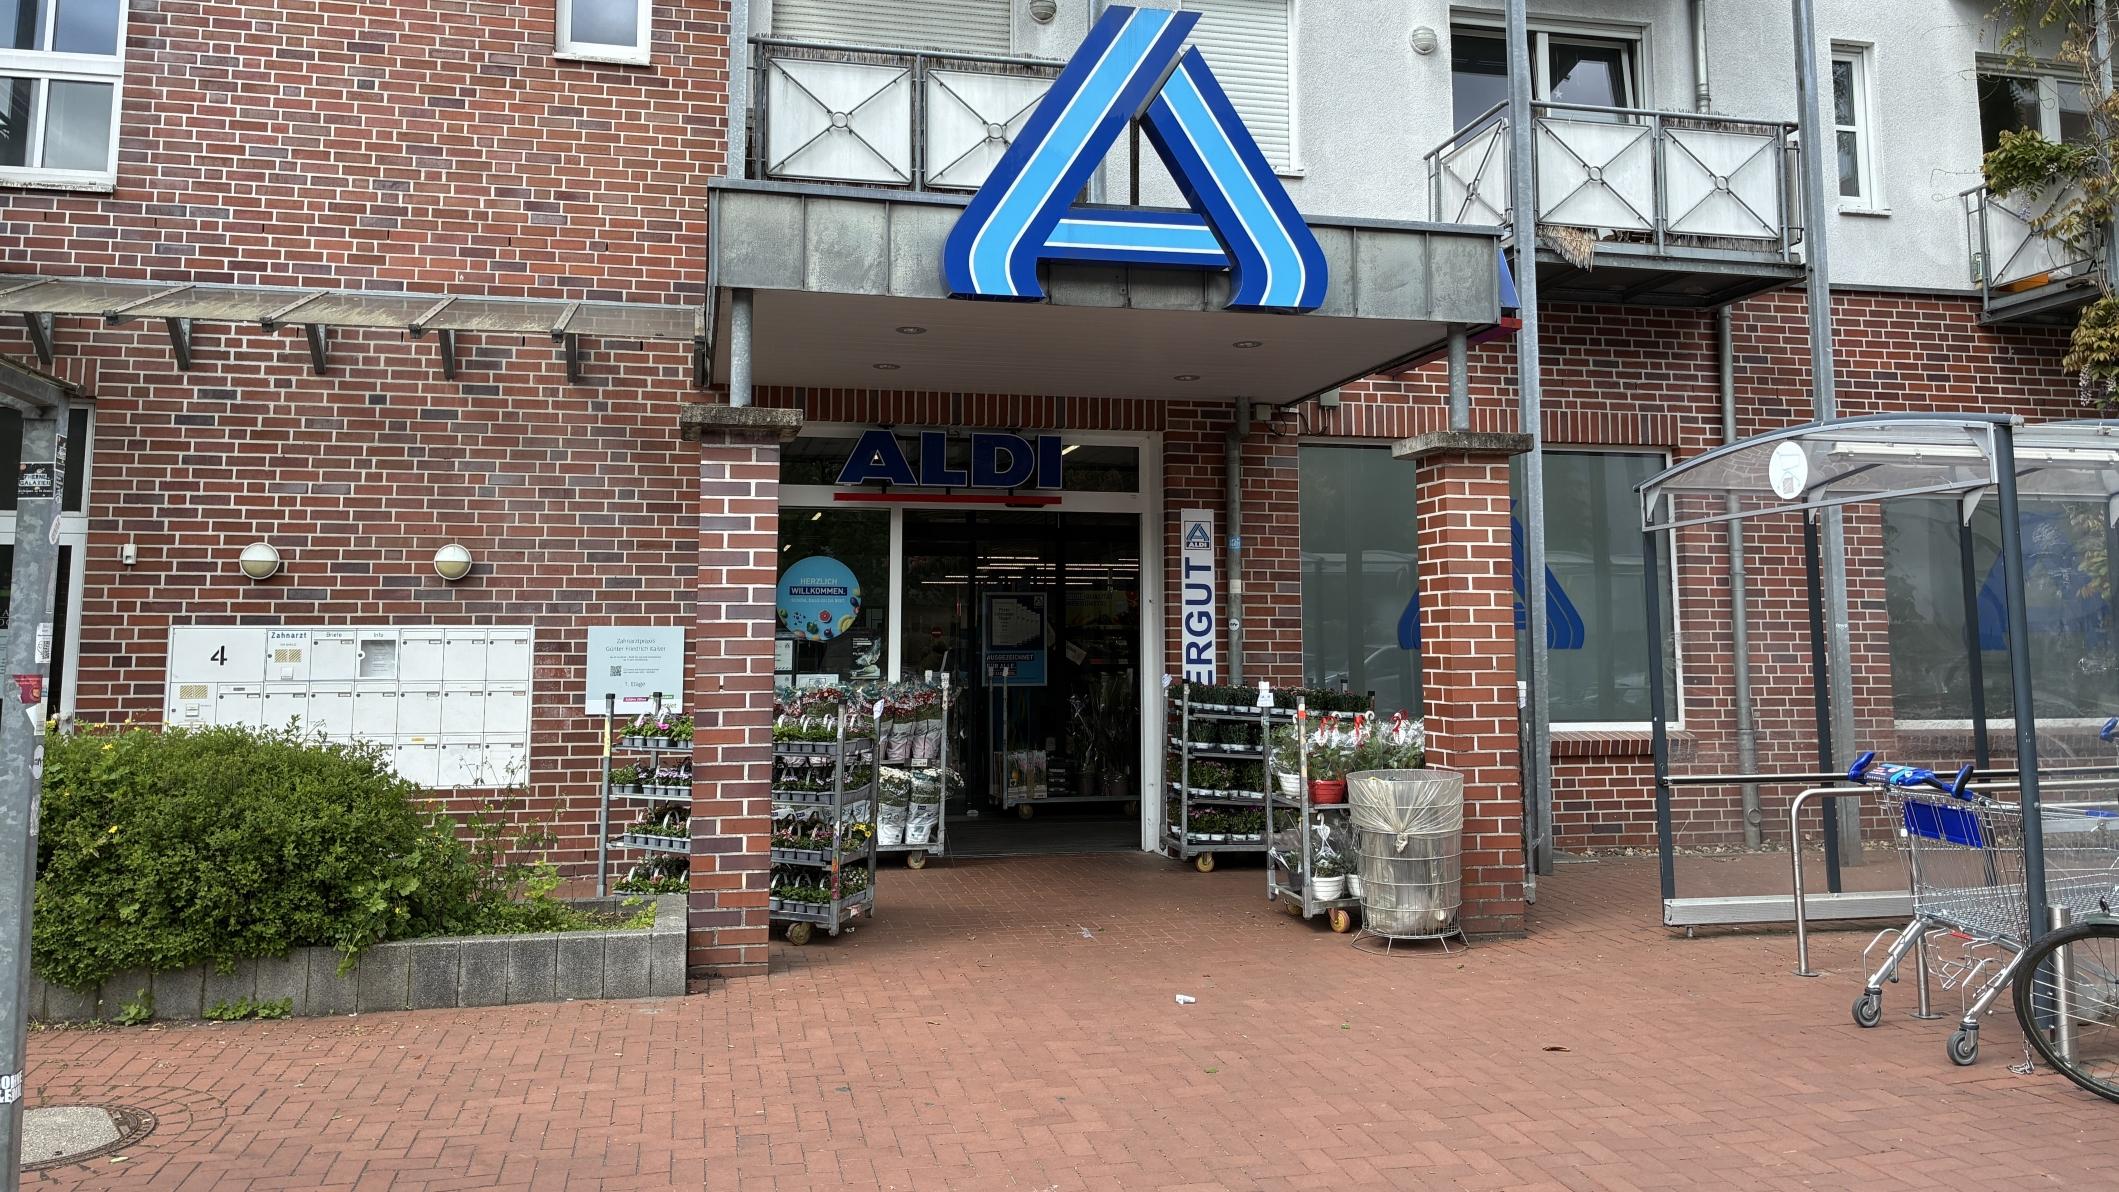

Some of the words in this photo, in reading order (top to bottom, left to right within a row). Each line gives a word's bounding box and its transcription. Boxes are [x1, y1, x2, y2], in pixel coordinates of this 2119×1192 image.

[834, 429, 1063, 490] ALDI
[800, 577, 838, 585] HERZLICH
[791, 587, 846, 595] WILLKOMMEN.
[270, 631, 307, 639] Zahnarzt
[210, 645, 228, 666] 4
